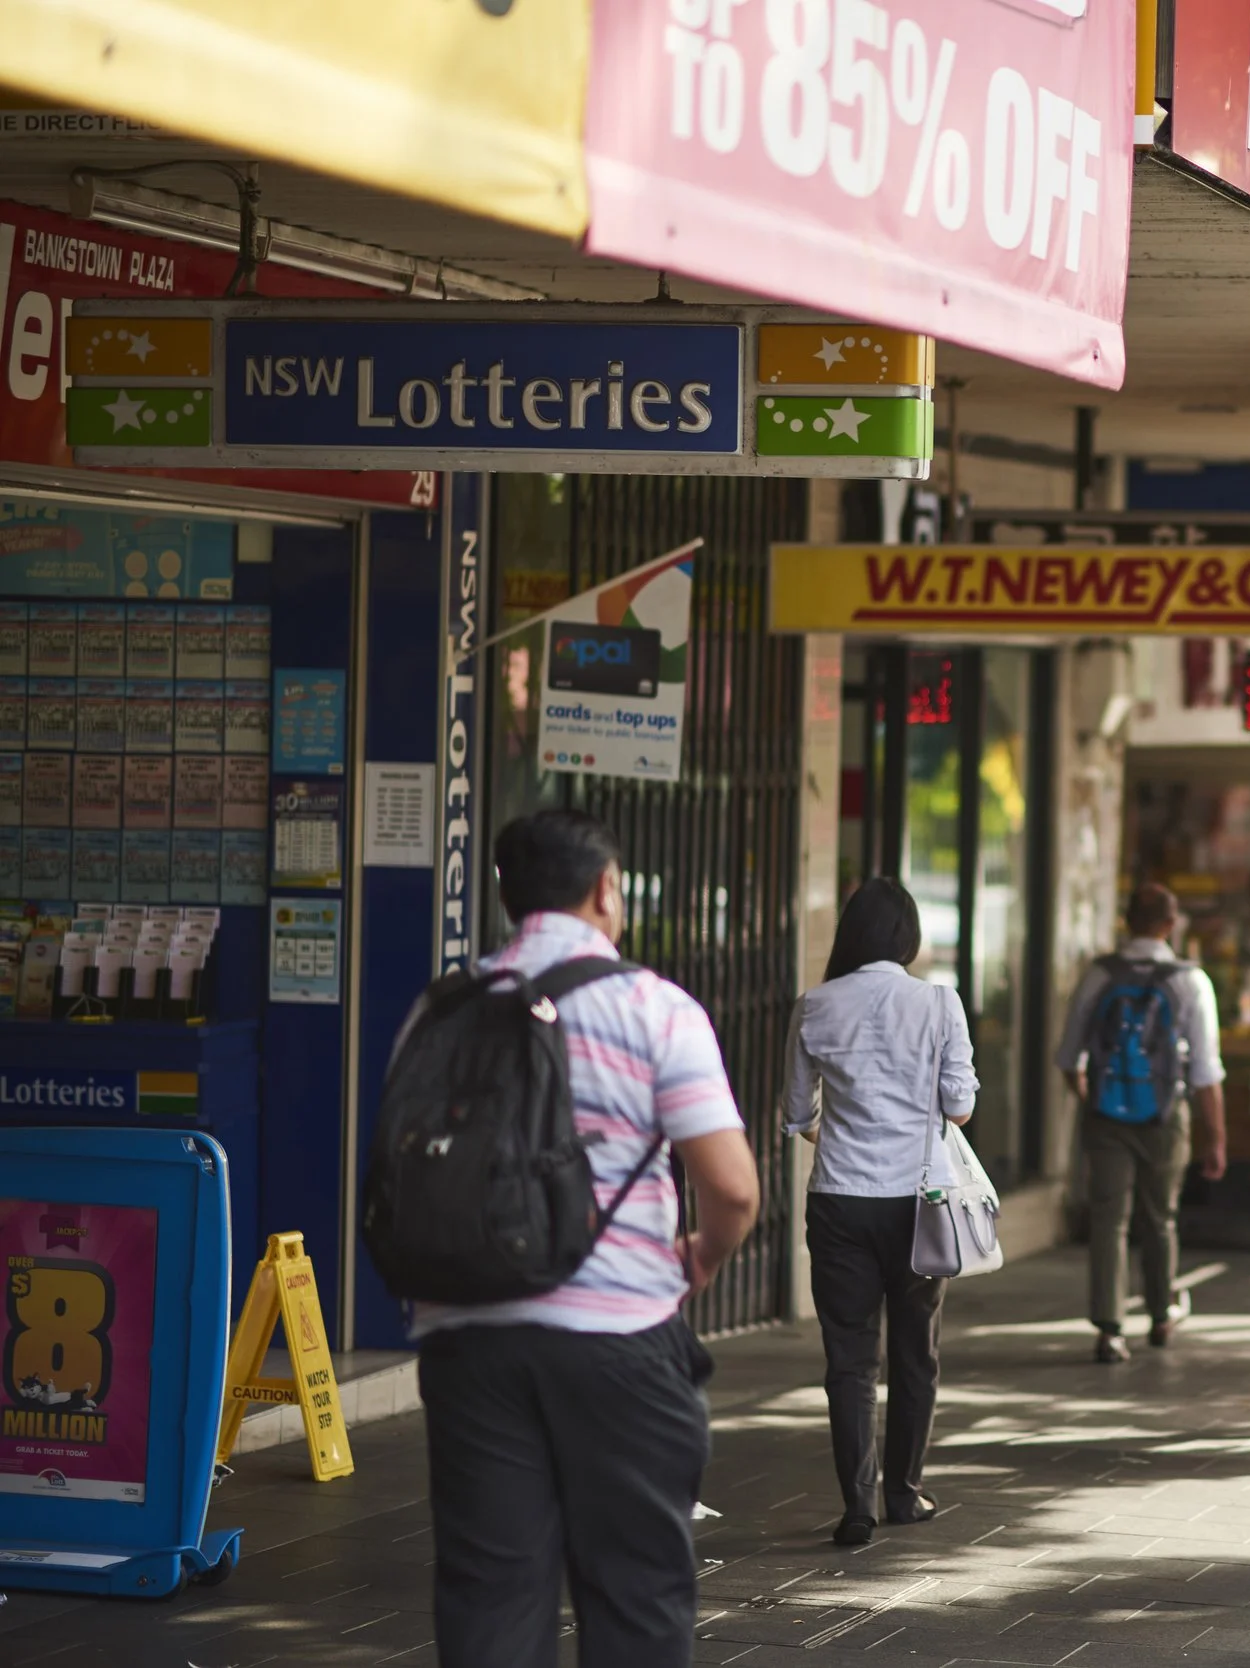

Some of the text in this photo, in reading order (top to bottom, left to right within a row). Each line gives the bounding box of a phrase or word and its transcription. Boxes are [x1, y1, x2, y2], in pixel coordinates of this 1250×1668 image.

[665, 25, 745, 153] TO
[25, 115, 108, 131] DIRECT
[761, 0, 1101, 273] 85% OFF
[24, 229, 174, 292] BANKSTOWN PLAZA
[244, 356, 712, 432] NSW Lotteries
[410, 470, 435, 506] 29
[546, 703, 591, 720] cards
[616, 708, 644, 729] top
[647, 715, 677, 730] ups
[0, 1075, 126, 1108] Lotteries
[8, 1256, 35, 1268] OVER
[286, 1272, 311, 1290] CAUTION
[306, 1369, 329, 1389] WATCH
[232, 1386, 294, 1403] CAUTION
[311, 1391, 332, 1409] YOUR
[3, 1409, 106, 1443] MILLION
[318, 1412, 333, 1430] STEP
[15, 1446, 35, 1454] GRAB
[43, 1448, 64, 1456] TICKET
[66, 1449, 89, 1458] TODAY.
